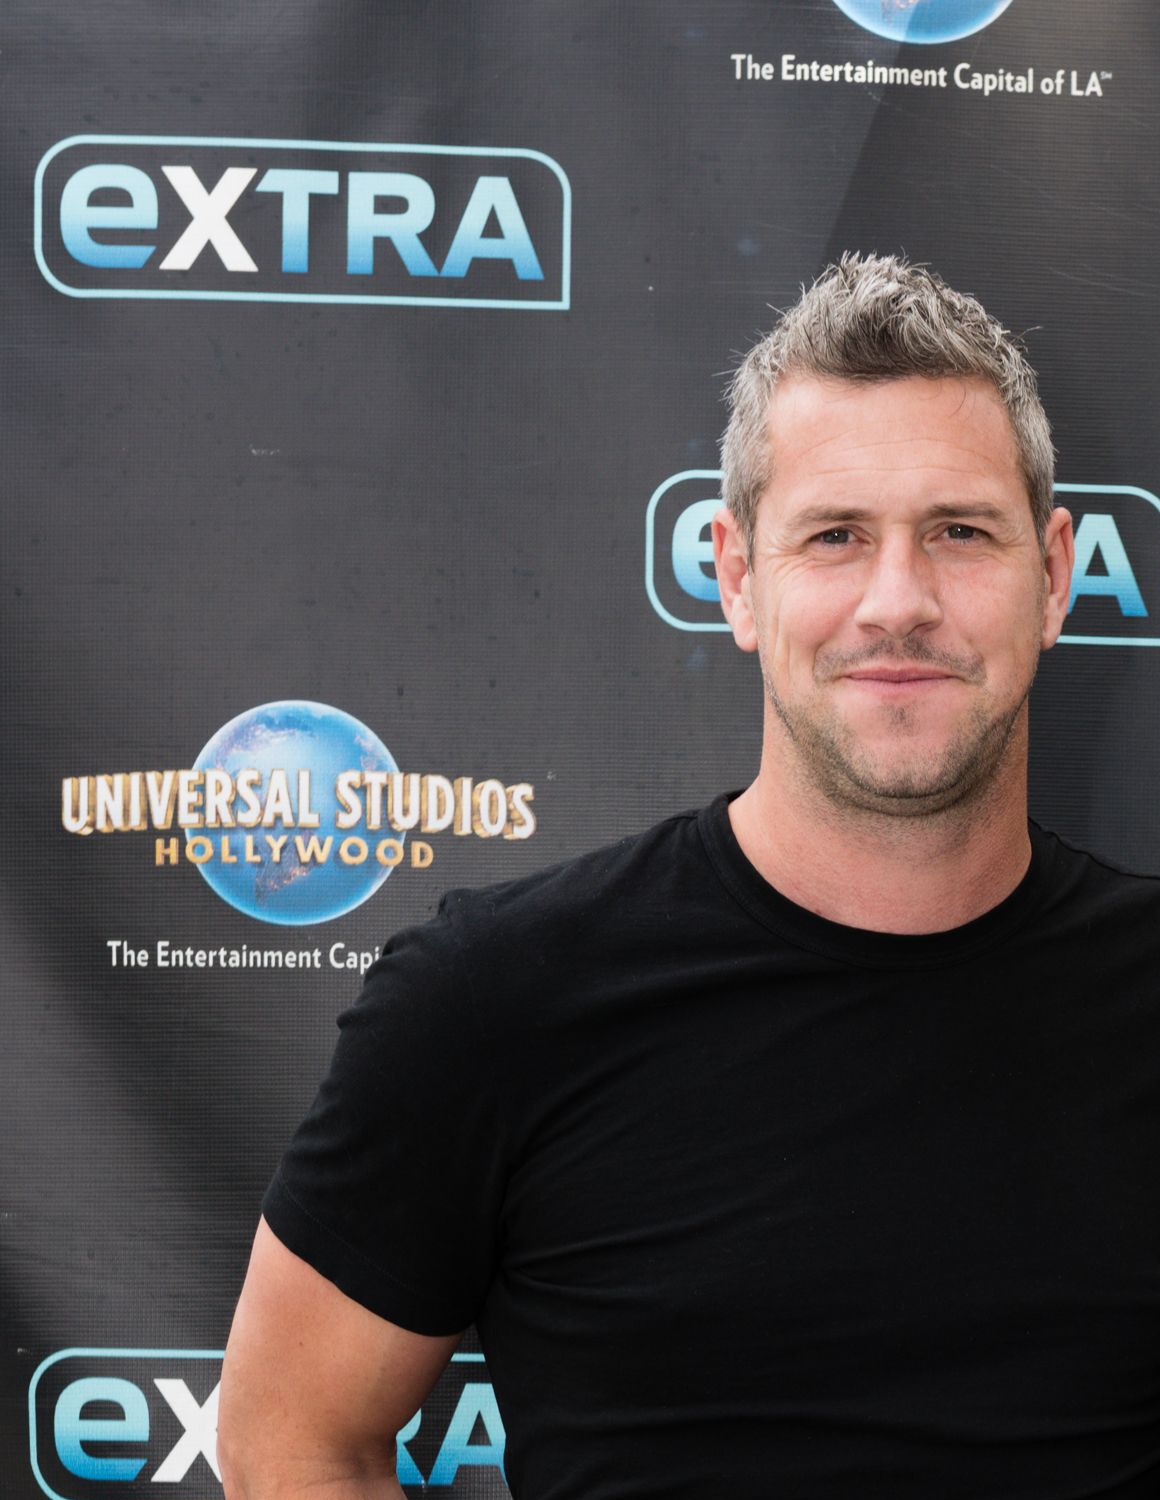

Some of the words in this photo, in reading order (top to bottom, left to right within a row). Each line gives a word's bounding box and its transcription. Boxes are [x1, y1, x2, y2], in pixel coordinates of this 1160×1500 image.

[731, 54, 774, 80] The
[781, 54, 947, 87] Entertainment
[953, 63, 1034, 97] Capital
[1040, 69, 1065, 94] of
[62, 768, 321, 836] UNIVERSAL
[335, 770, 537, 841] STUDIOS
[155, 835, 434, 869] HOLLYWOOD
[107, 940, 149, 967] The
[156, 940, 322, 968] Entertainment
[328, 942, 381, 975] Capi
